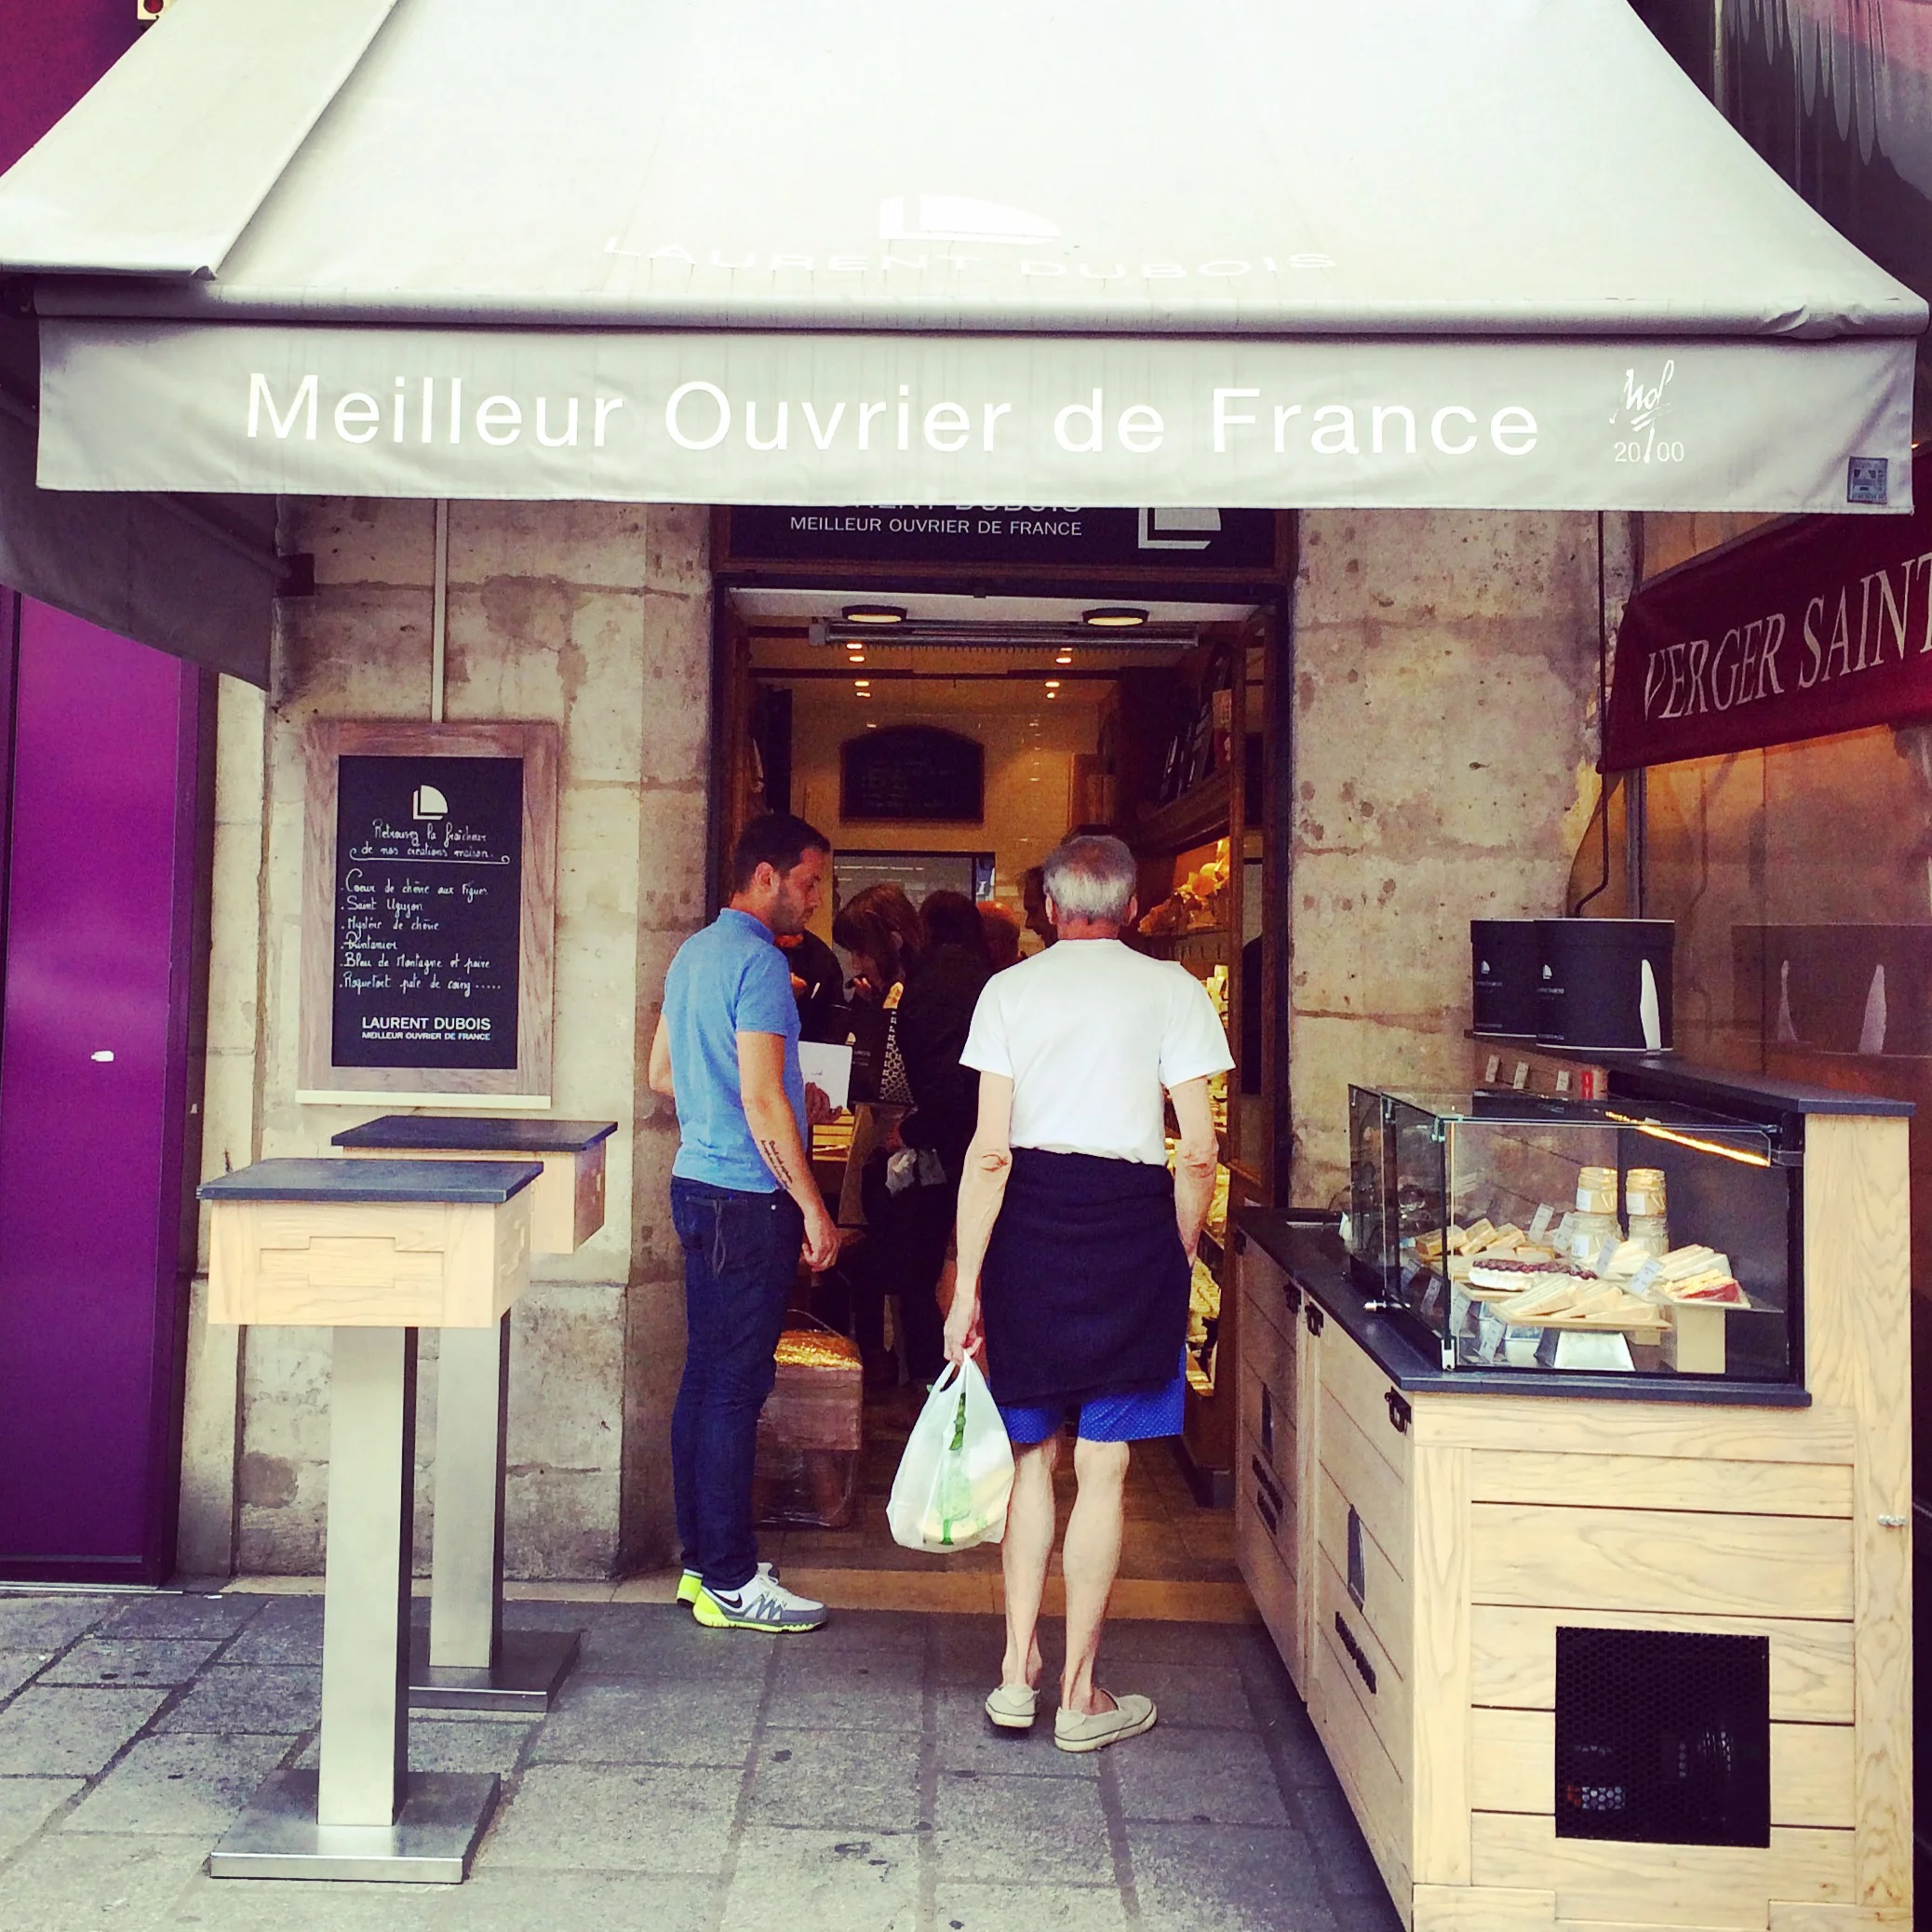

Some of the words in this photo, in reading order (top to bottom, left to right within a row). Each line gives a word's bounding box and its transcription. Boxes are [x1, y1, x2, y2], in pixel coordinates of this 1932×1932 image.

[604, 236, 982, 272] LAURENT
[1020, 253, 1336, 279] DUBOIS
[247, 372, 624, 447] Meilleur
[664, 381, 1013, 454] Ouvrier
[1053, 387, 1165, 453] de
[1212, 387, 1538, 456] France
[789, 517, 882, 532] MEILLEUR
[889, 517, 970, 533] OUVRIER
[977, 520, 1002, 534] DE
[1010, 521, 1082, 536] FRANCE
[1644, 612, 1786, 722] VERGER
[1797, 551, 1932, 690] SAINT
[361, 841, 373, 855] de
[384, 878, 395, 893] de
[393, 918, 404, 931] de
[344, 951, 372, 968] Bleu
[378, 953, 390, 968] de
[449, 952, 460, 968] et
[430, 973, 441, 989] de
[361, 1016, 429, 1029] LAURENT
[434, 1017, 491, 1030] DUBOIS
[361, 1031, 403, 1040] MEILLEUR
[405, 1032, 442, 1040] OUVRIER
[444, 1032, 456, 1040] DE
